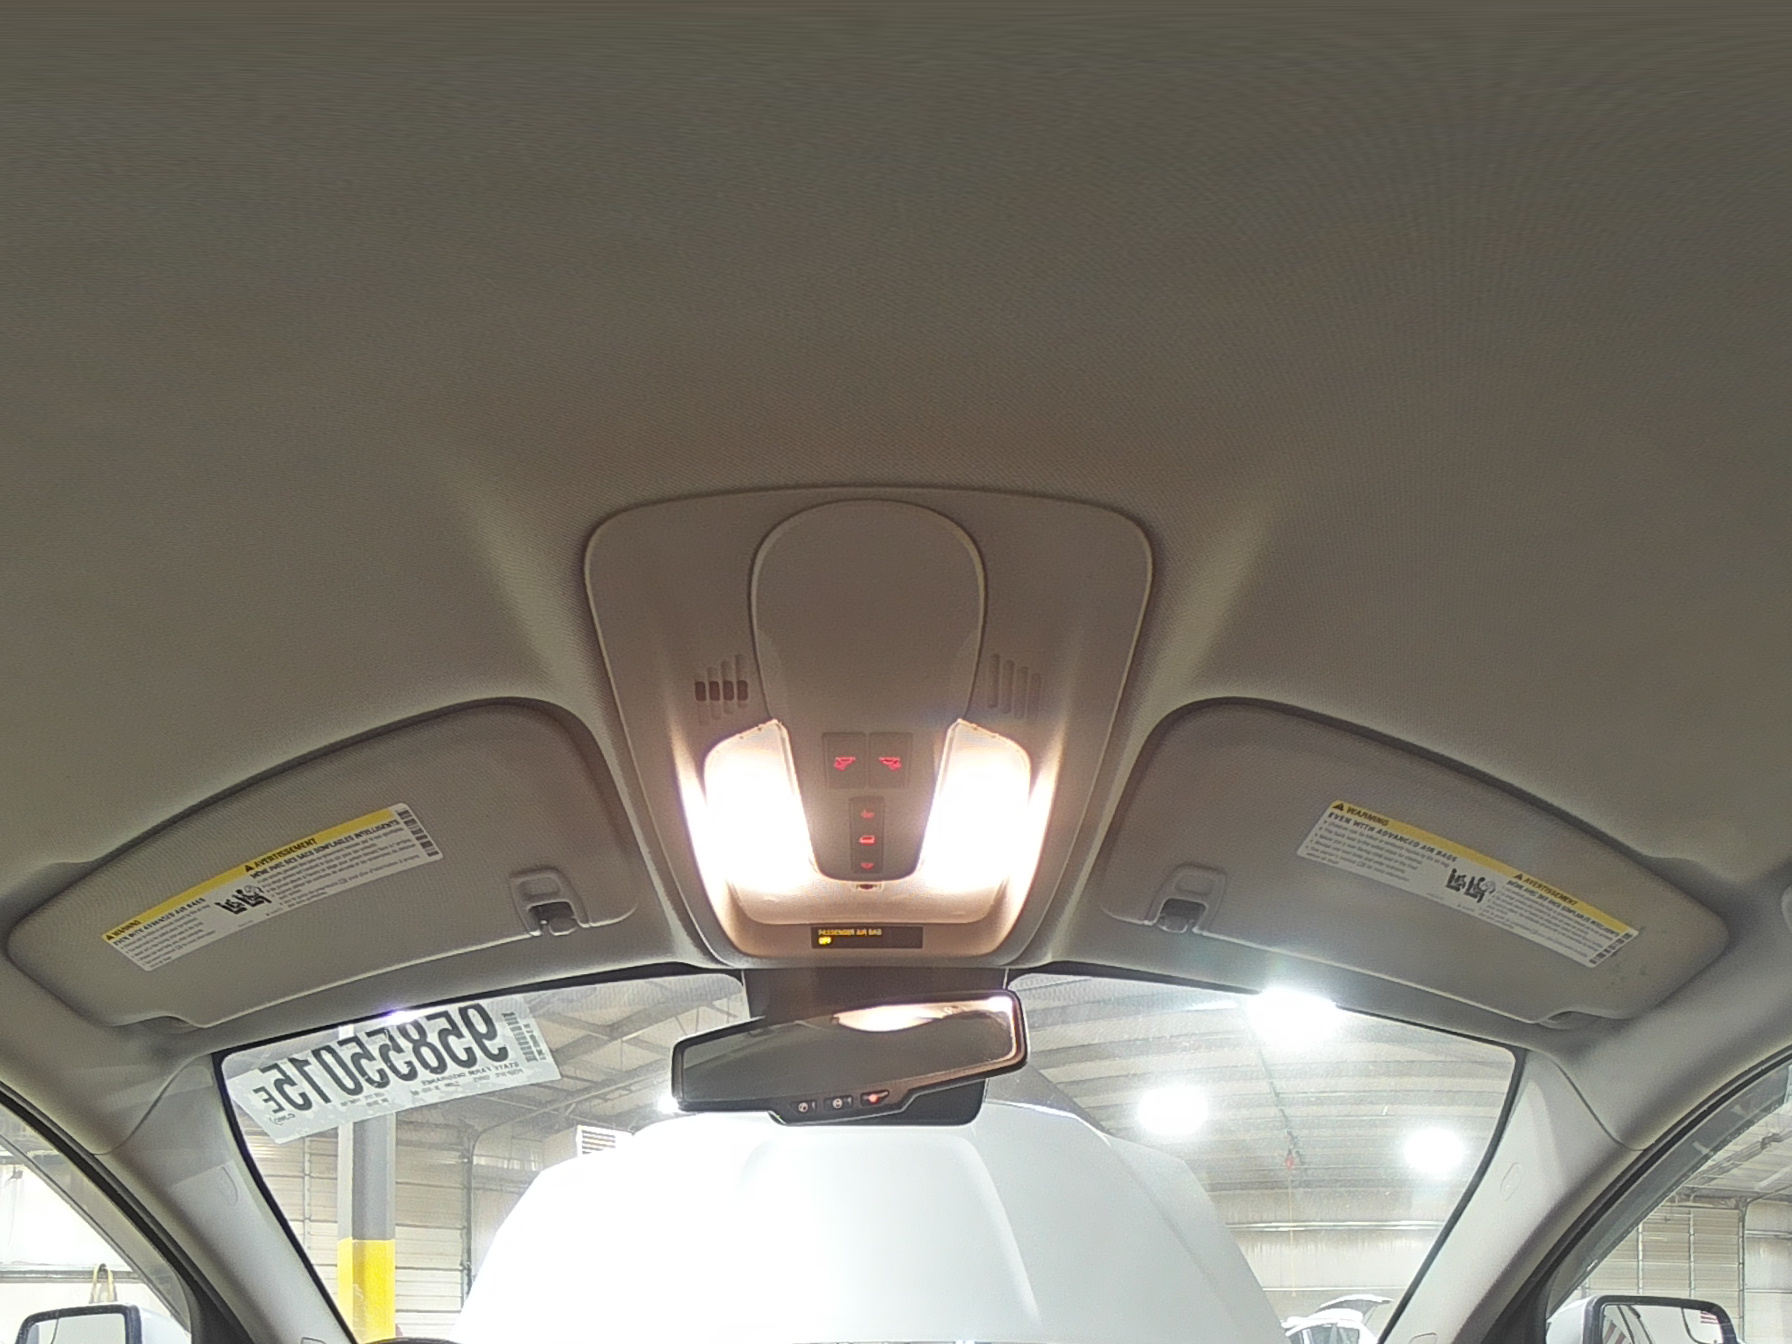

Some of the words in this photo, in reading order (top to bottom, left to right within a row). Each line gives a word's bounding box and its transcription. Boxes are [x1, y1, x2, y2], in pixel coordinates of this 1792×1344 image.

[1346, 806, 1390, 827] WARNING
[253, 837, 318, 868] AVERTISSEMENT
[1523, 878, 1578, 906] AVERTISSEMENT
